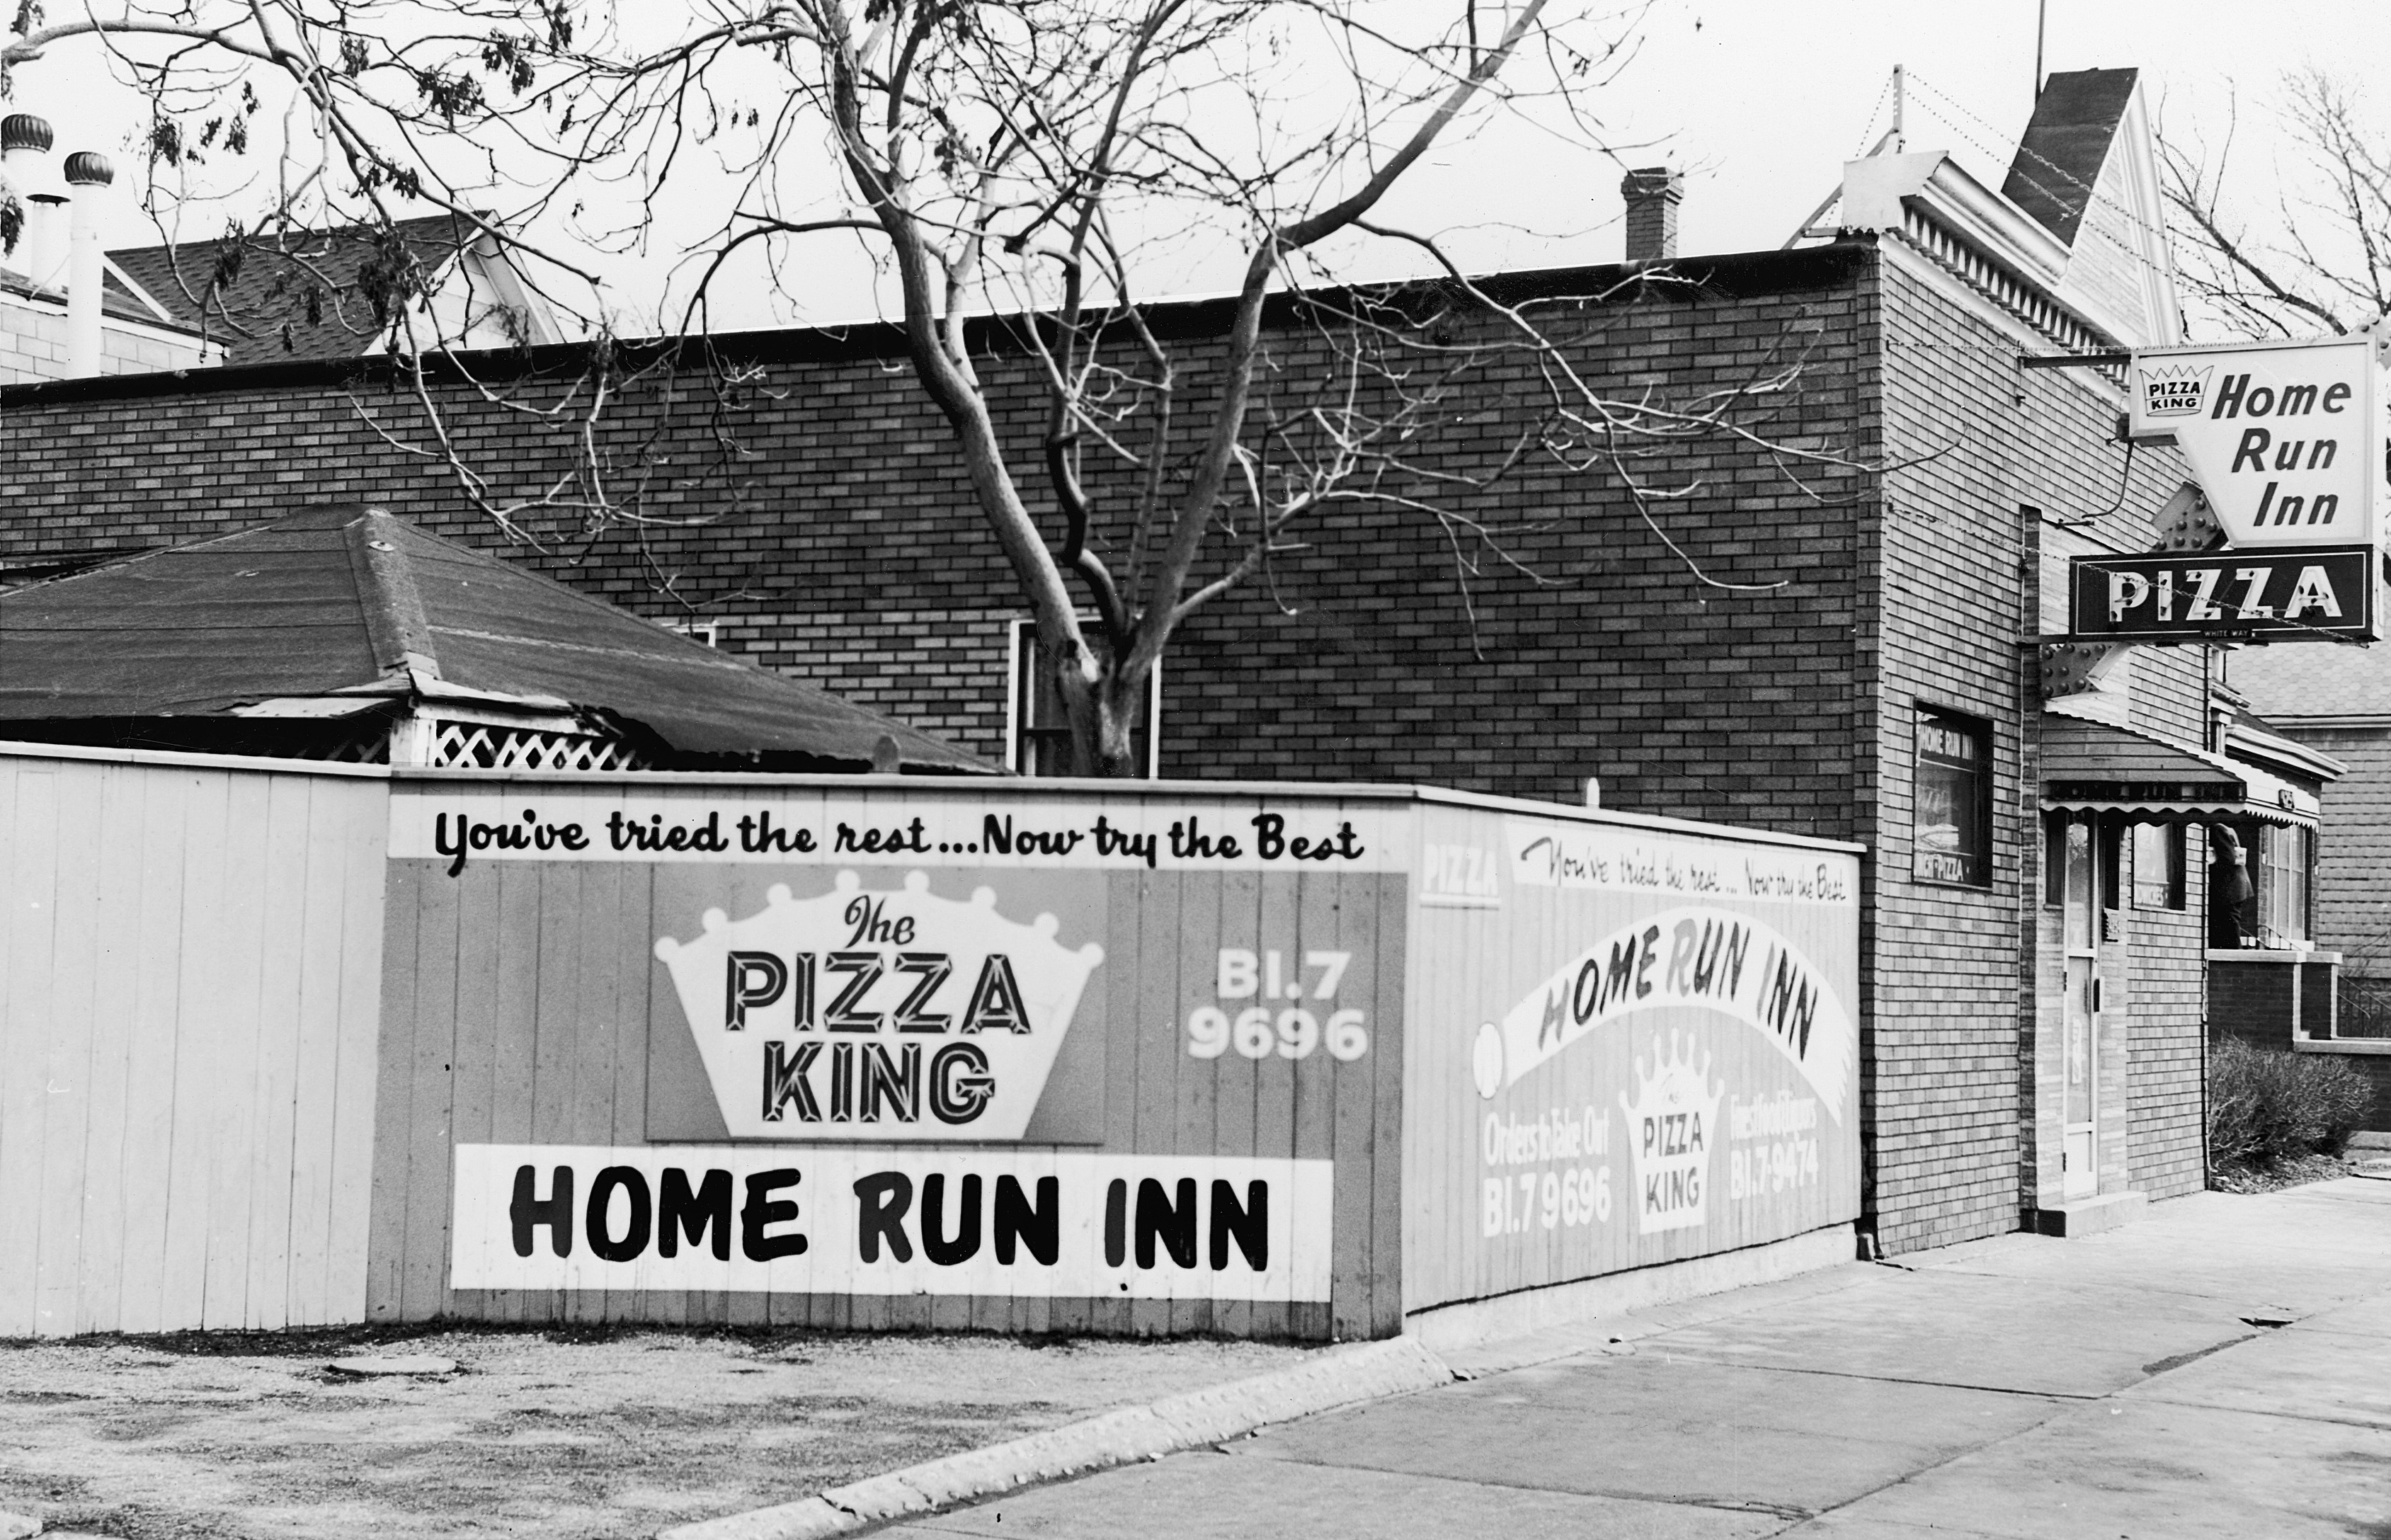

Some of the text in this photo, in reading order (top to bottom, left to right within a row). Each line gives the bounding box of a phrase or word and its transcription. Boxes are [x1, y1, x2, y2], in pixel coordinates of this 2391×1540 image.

[2150, 382, 2200, 397] PIZZA
[2151, 398, 2196, 410] KING
[2211, 374, 2351, 419] Home
[2231, 428, 2337, 473] Run
[2253, 481, 2339, 526] Inn
[2109, 566, 2342, 622] PIZZA
[1920, 724, 1944, 755] HOME
[435, 809, 589, 877] You've
[606, 811, 729, 852] tried
[737, 811, 817, 853] the
[1090, 816, 1157, 868] try
[1168, 816, 1243, 858] the
[1251, 814, 1364, 861] Best
[1620, 847, 1660, 886] tried
[1422, 843, 1499, 896] PIZZA
[845, 895, 915, 948] The
[726, 951, 1032, 1034] PIZZA
[1218, 948, 1352, 999] BI.7
[1538, 918, 1818, 1062] HOME RUN INN
[1187, 1006, 1369, 1061] 9696
[763, 1041, 995, 1125] KING
[1643, 1112, 1704, 1158] PIZZA
[1541, 1165, 1611, 1229] 9696
[1646, 1166, 1699, 1215] KING
[510, 1165, 1269, 1272] HOME RUN INN
